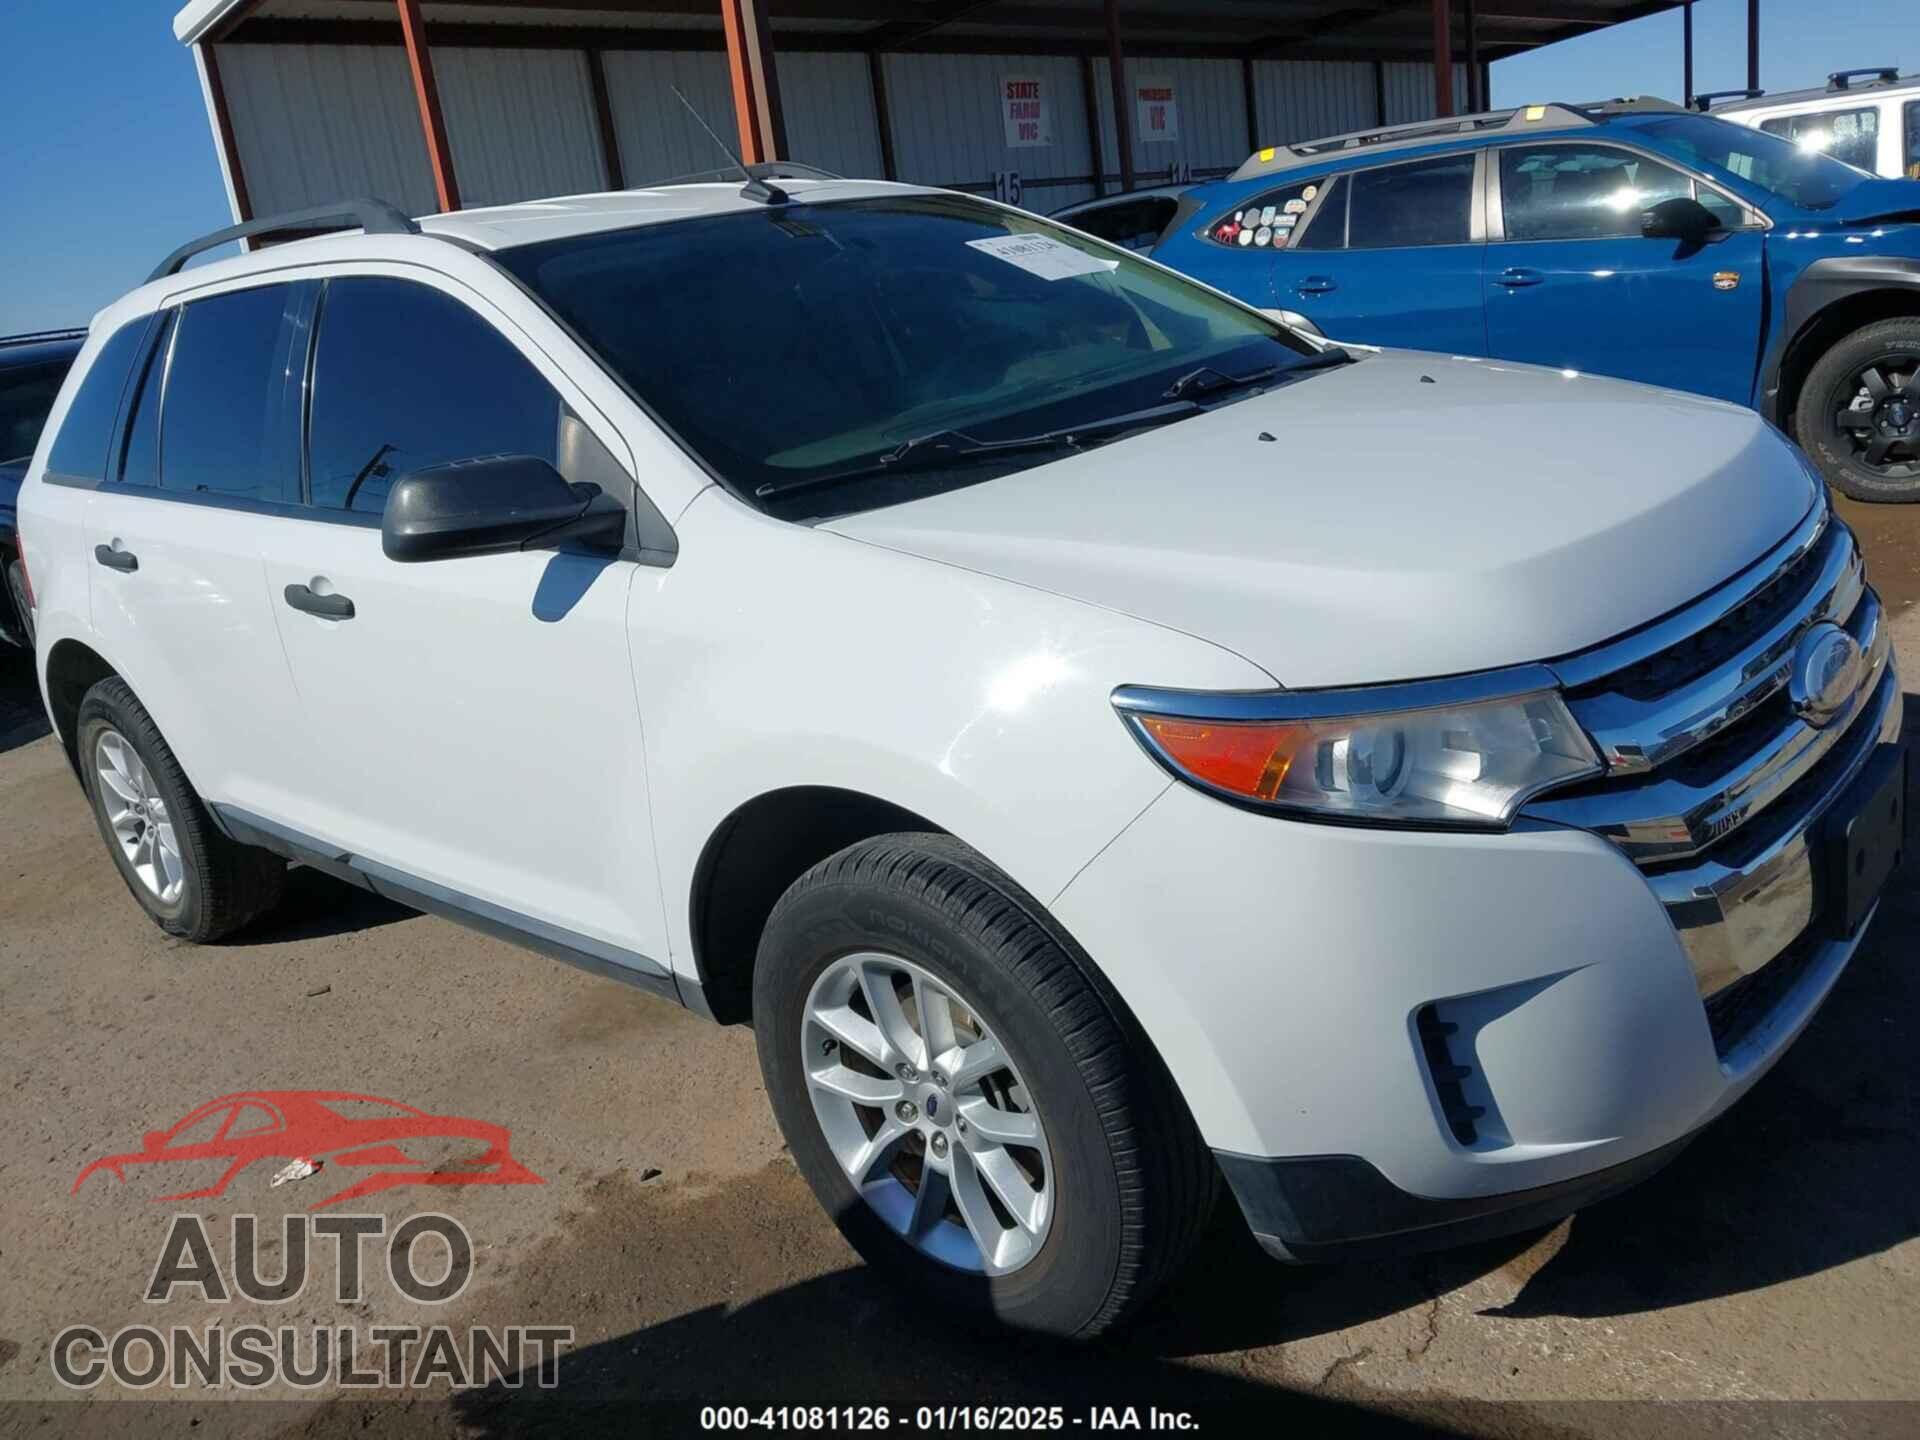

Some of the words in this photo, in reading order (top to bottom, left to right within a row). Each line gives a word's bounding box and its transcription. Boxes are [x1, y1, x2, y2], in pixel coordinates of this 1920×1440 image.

[1008, 81, 1040, 99] STATE
[1010, 102, 1040, 120] FARM
[1019, 122, 1039, 140] VIC
[997, 172, 1020, 205] 15
